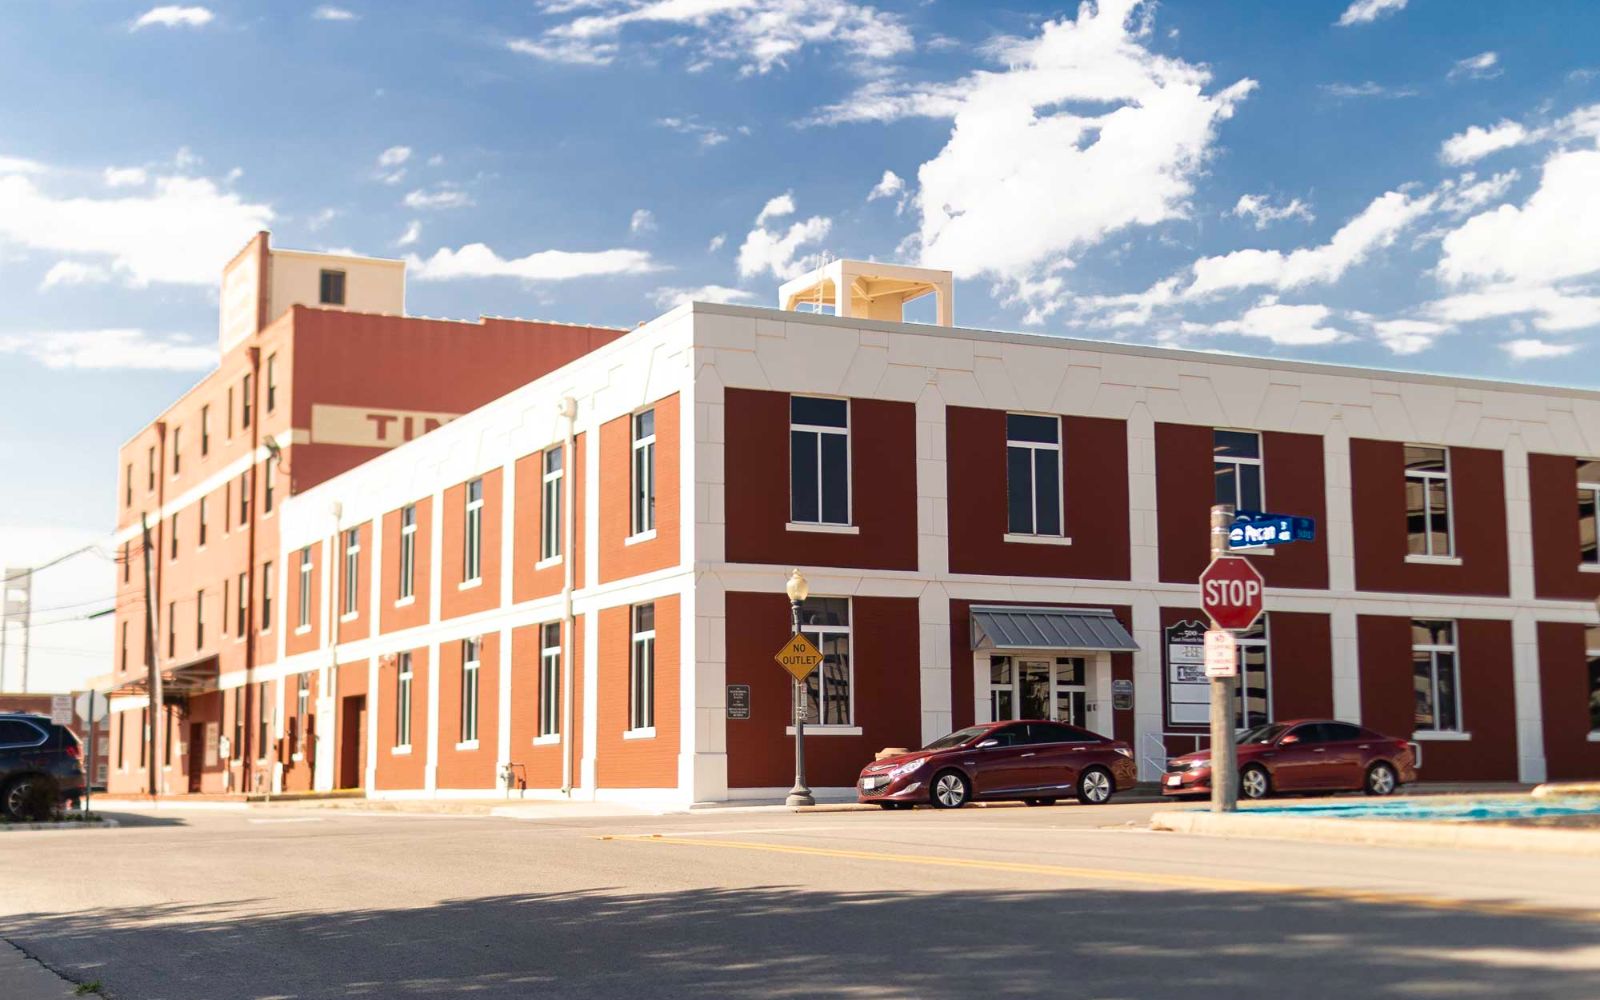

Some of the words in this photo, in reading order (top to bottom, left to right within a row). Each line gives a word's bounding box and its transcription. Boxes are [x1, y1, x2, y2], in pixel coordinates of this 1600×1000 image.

[1205, 579, 1259, 606] STOP
[793, 644, 806, 653] NO
[782, 656, 817, 665] OUTLET
